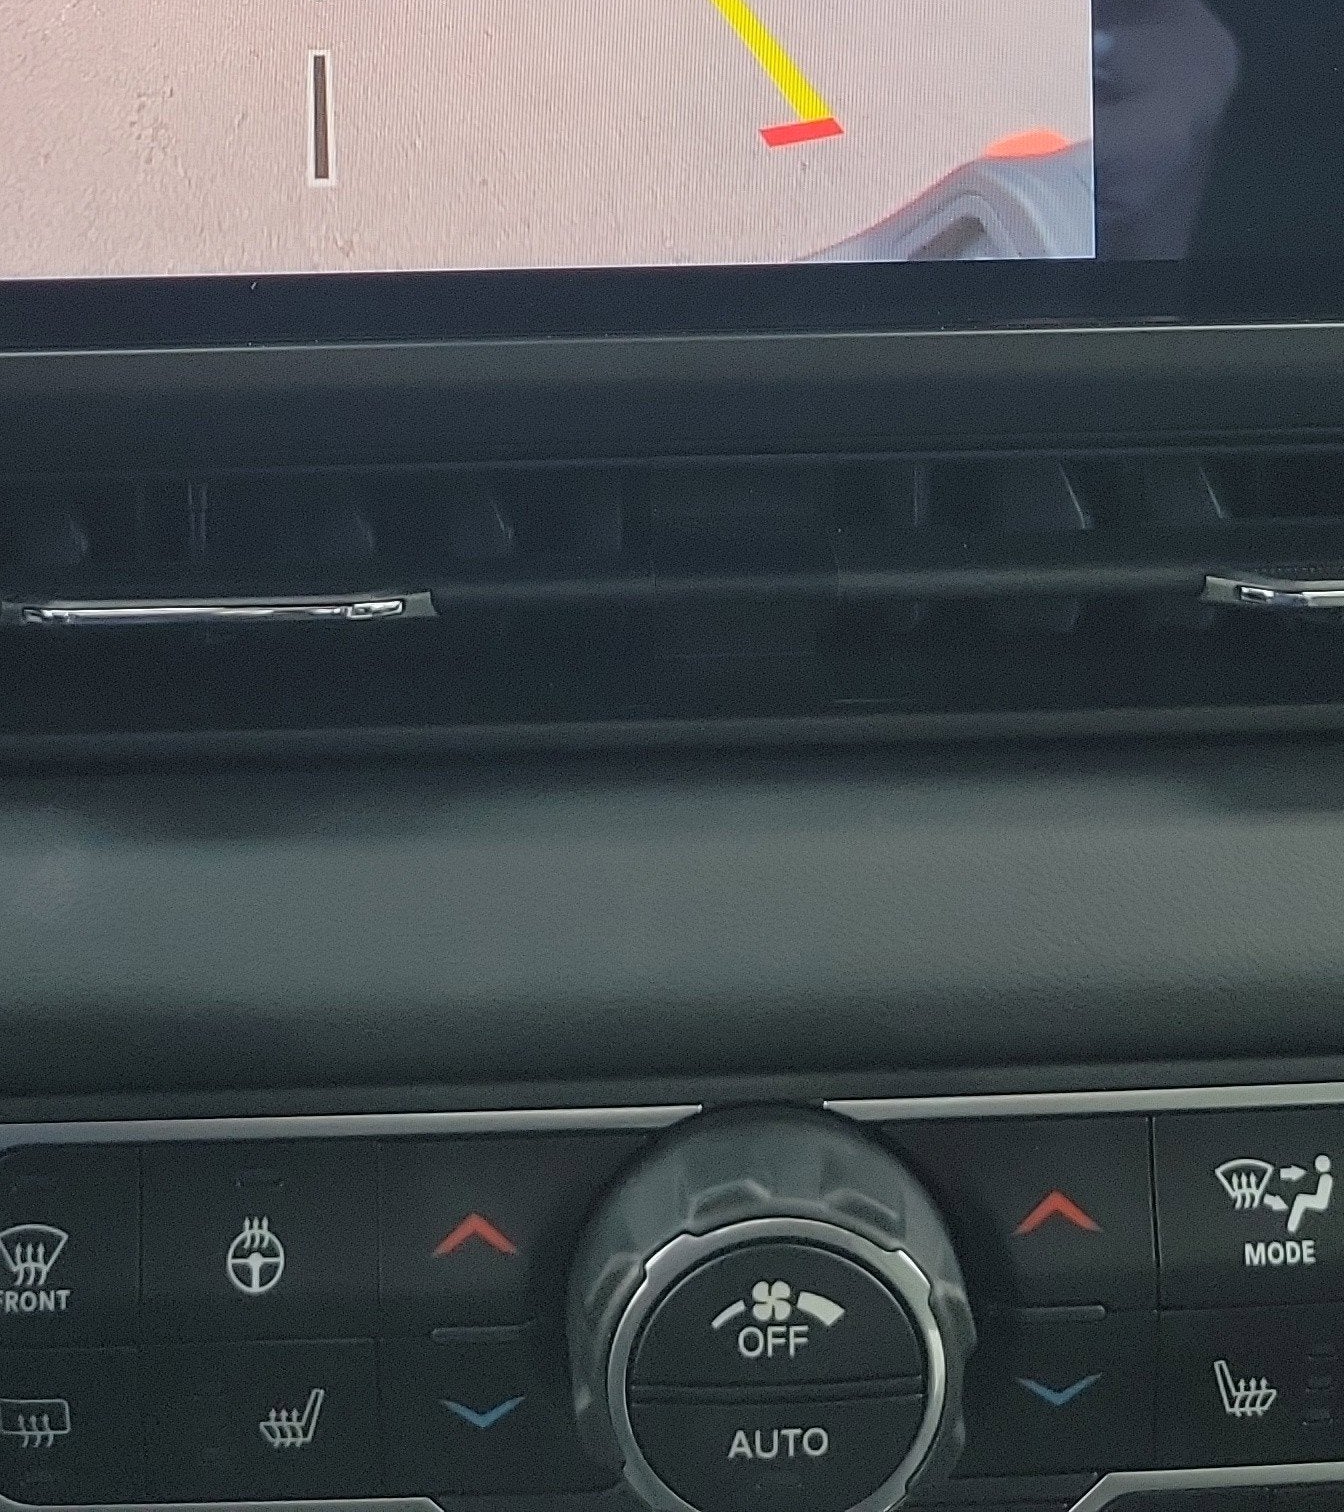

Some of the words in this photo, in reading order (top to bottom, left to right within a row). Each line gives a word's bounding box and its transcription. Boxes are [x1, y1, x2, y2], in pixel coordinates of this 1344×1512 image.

[1244, 1240, 1316, 1266] MODE
[738, 1325, 809, 1358] OFF
[729, 1427, 829, 1459] AUTO
